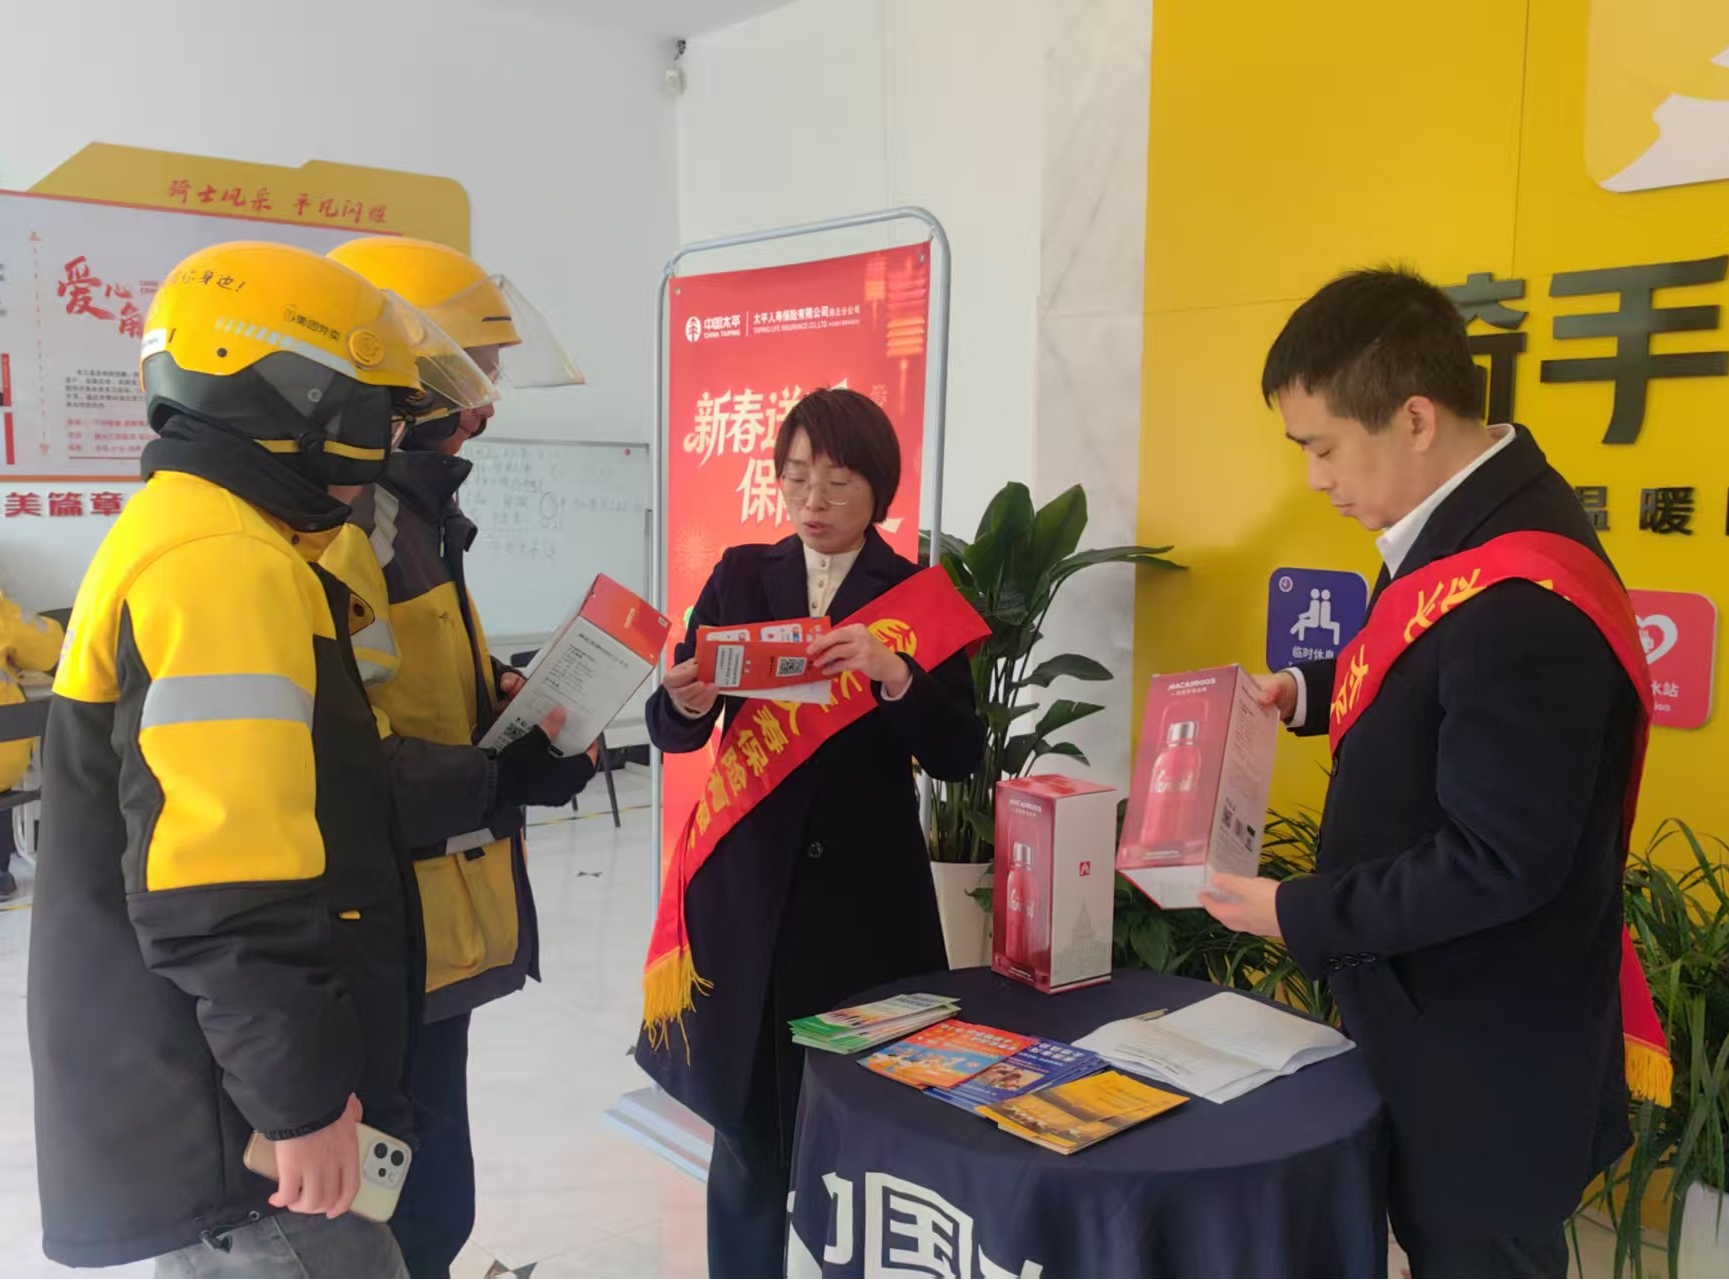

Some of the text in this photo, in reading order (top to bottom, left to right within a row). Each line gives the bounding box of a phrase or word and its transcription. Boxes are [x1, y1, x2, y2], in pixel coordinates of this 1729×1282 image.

[703, 315, 741, 330] 中国太平
[703, 331, 720, 339] CHINA
